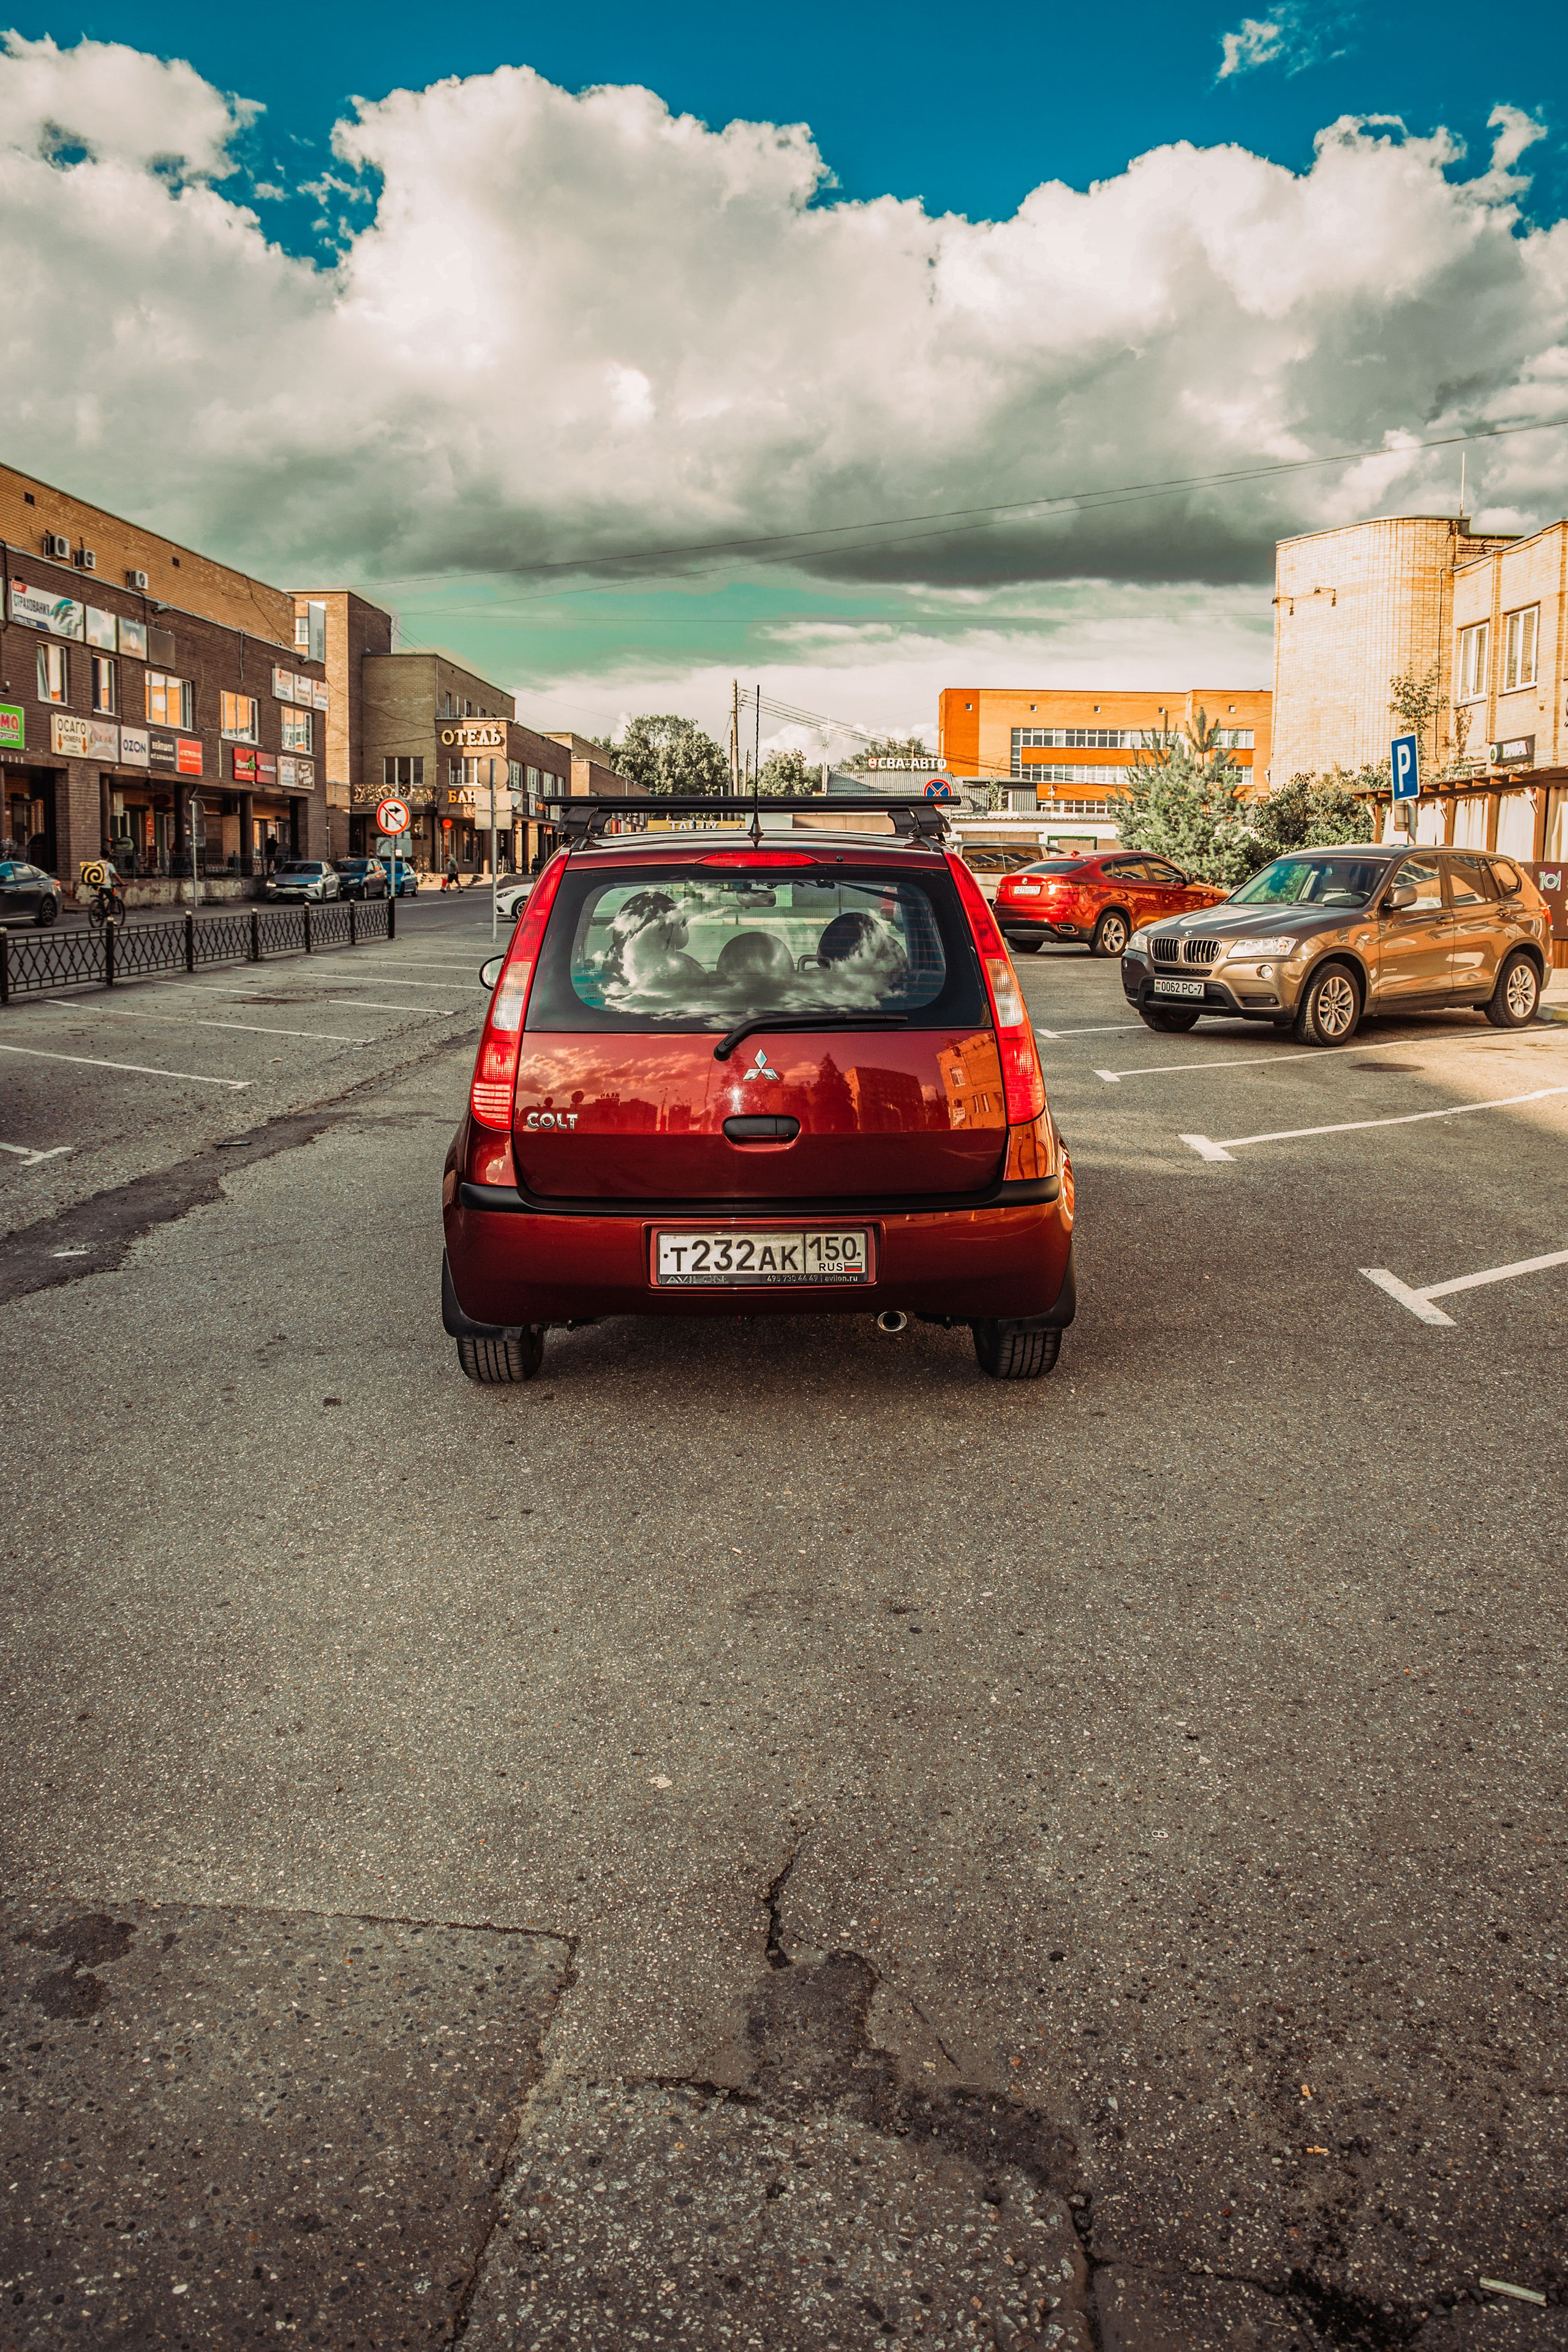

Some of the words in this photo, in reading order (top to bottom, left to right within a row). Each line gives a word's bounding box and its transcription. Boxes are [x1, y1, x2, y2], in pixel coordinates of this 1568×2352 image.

[13, 594, 50, 616] СТРАХОВАНИЯ
[57, 718, 86, 735] ОСАГО
[63, 734, 81, 744] НОМЕРА
[441, 728, 502, 746] ОТЕЛЬ
[123, 739, 146, 753] OZON
[1397, 743, 1411, 792] P
[448, 790, 476, 804] БАН
[1161, 981, 1180, 993] 0062
[1182, 983, 1203, 995] PC-7
[527, 1112, 578, 1129] COLT
[808, 1236, 857, 1261] 150
[819, 1262, 843, 1272] RUS
[666, 1275, 727, 1284] AVILON
